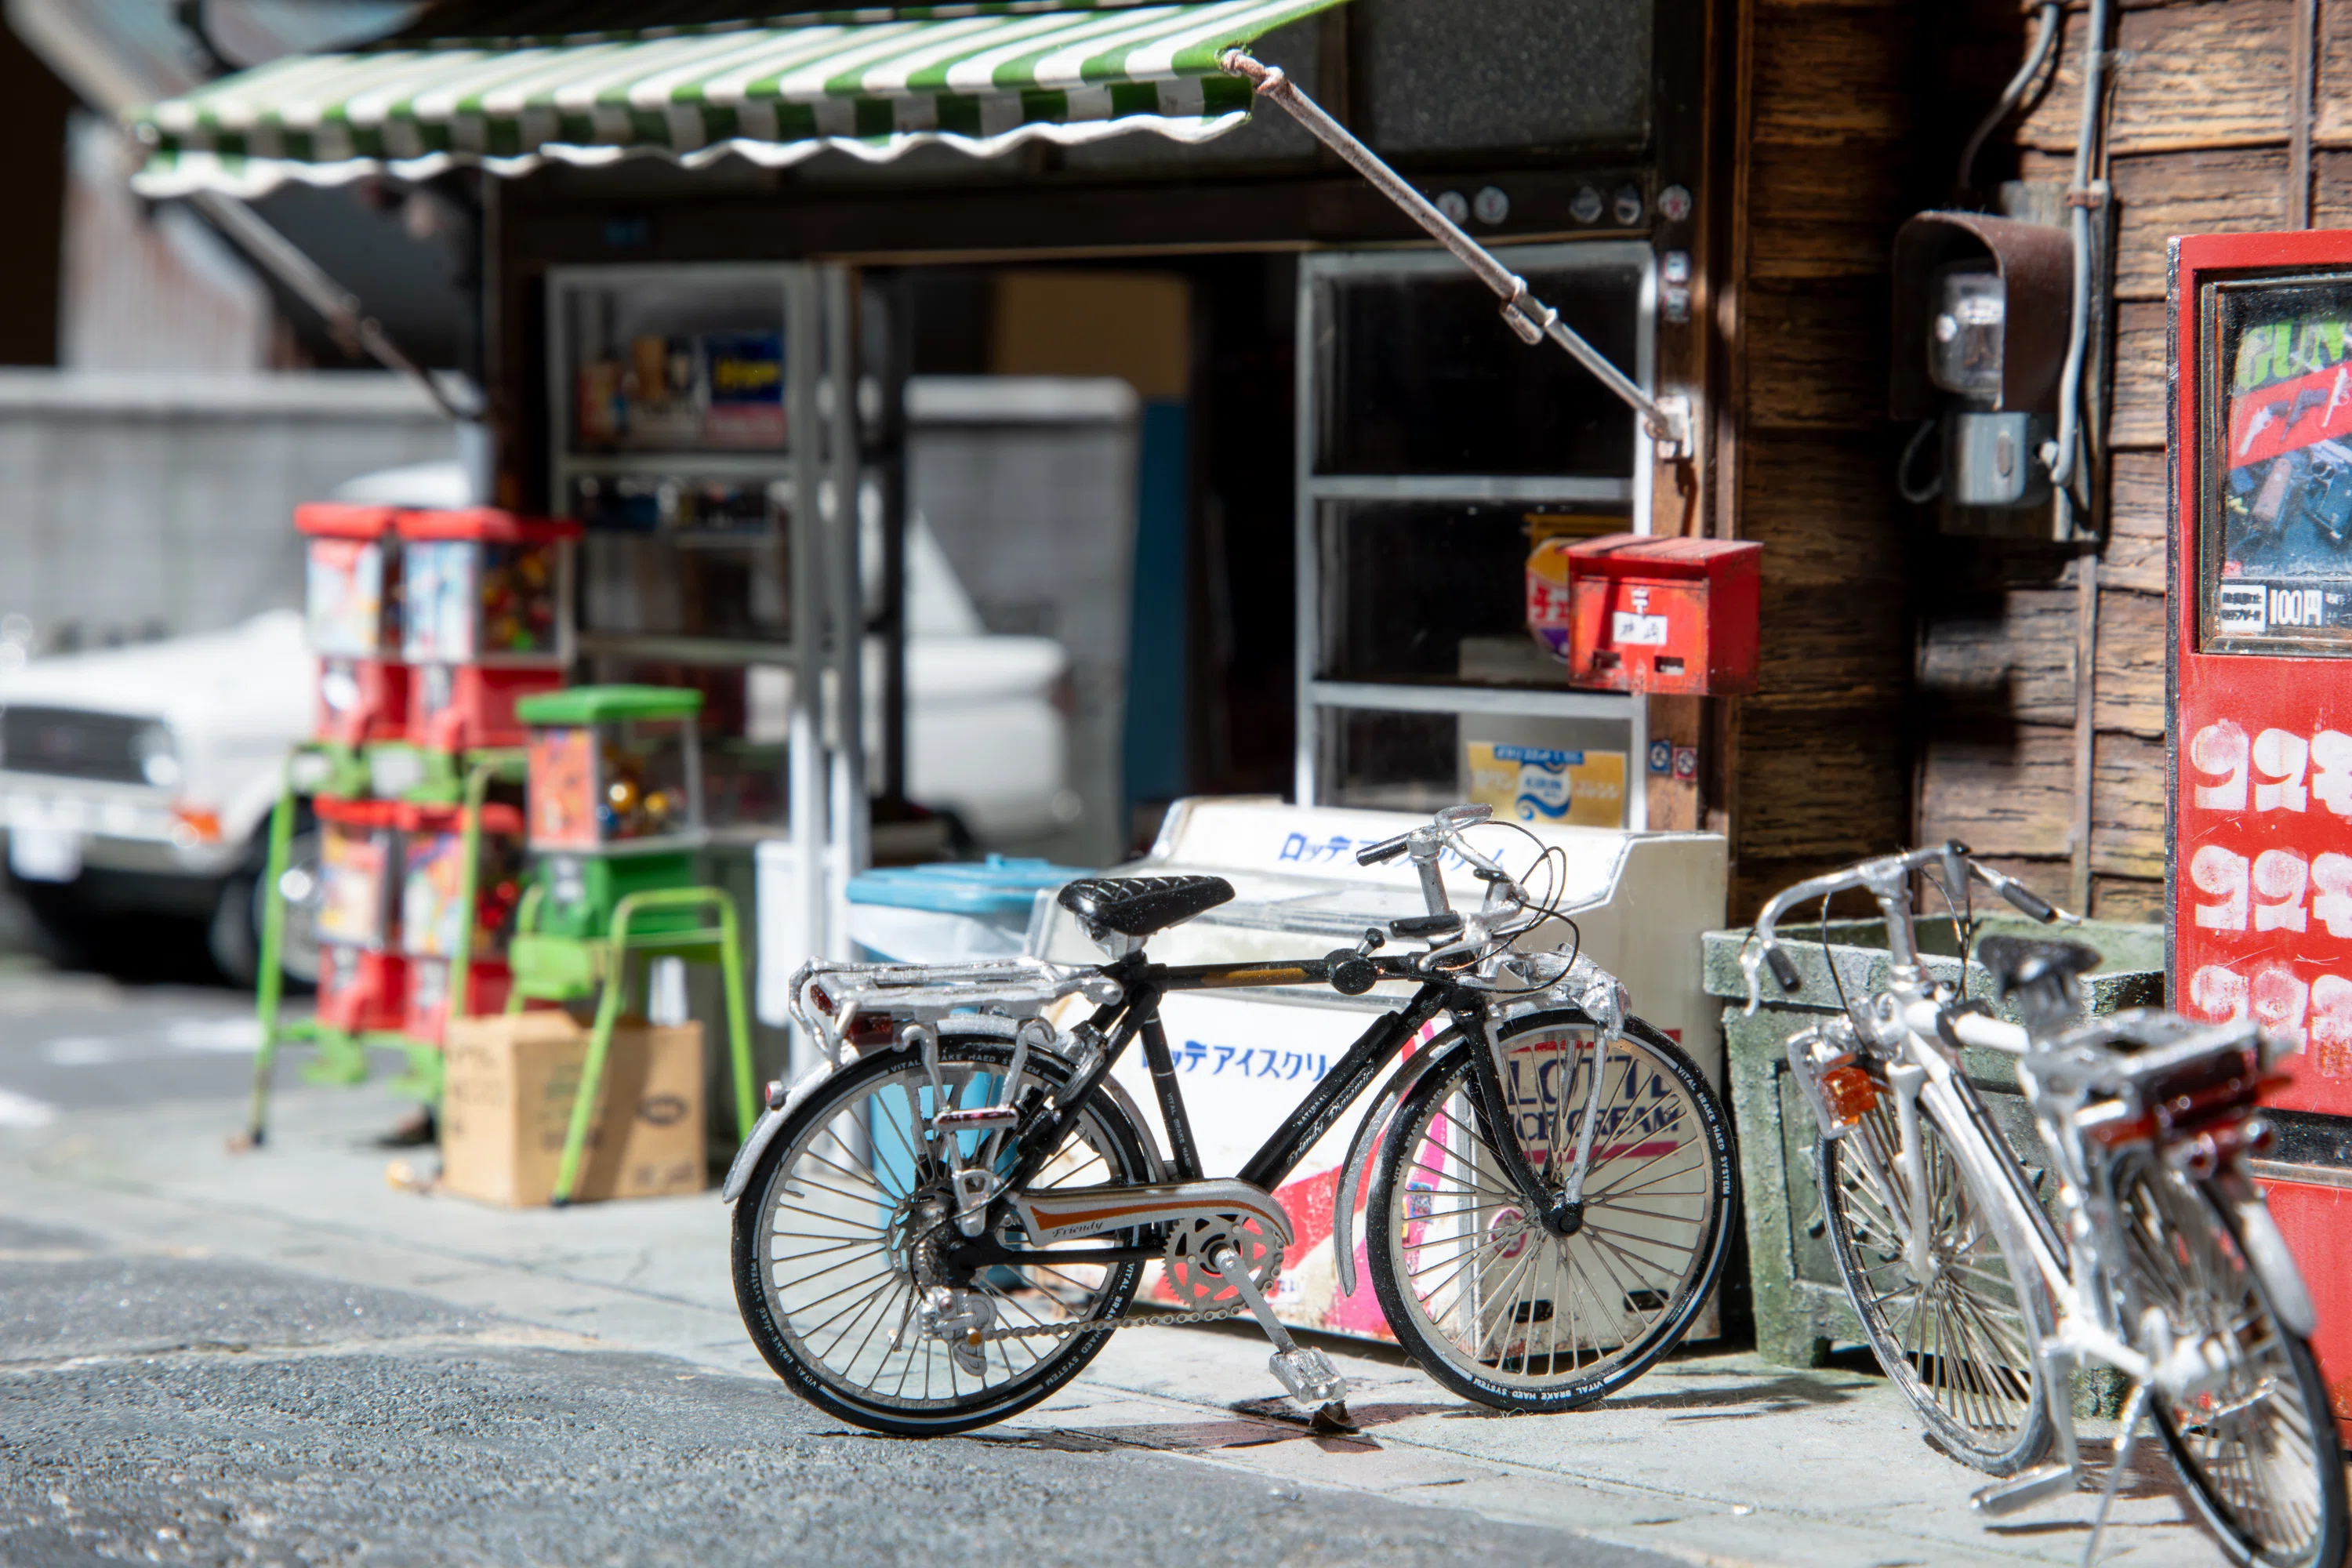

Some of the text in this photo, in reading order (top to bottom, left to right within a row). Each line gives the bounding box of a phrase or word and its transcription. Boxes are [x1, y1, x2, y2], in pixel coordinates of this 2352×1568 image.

[2235, 316, 2346, 389] GUN
[2270, 590, 2322, 626] 100円
[891, 1060, 921, 1073] VITAL
[1142, 1040, 1332, 1082] ッテアイスクリ
[1167, 1092, 1177, 1116] VITAL
[1297, 1094, 1329, 1127] NATIONAL
[1677, 1065, 1697, 1091] VITAL
[1697, 1092, 1716, 1123] BRAKE
[1720, 1155, 1731, 1195] SYSTEM
[750, 1261, 762, 1301] SYSTEM
[1119, 1263, 1135, 1290] VITAL
[1105, 1296, 1123, 1321] BRAK
[796, 1367, 817, 1388] VITAL
[1045, 1356, 1080, 1387] SYSTEM
[1473, 1377, 1508, 1396] SYSTEM
[1541, 1390, 1572, 1401] BRAKE
[1576, 1380, 1604, 1395] VITAL
